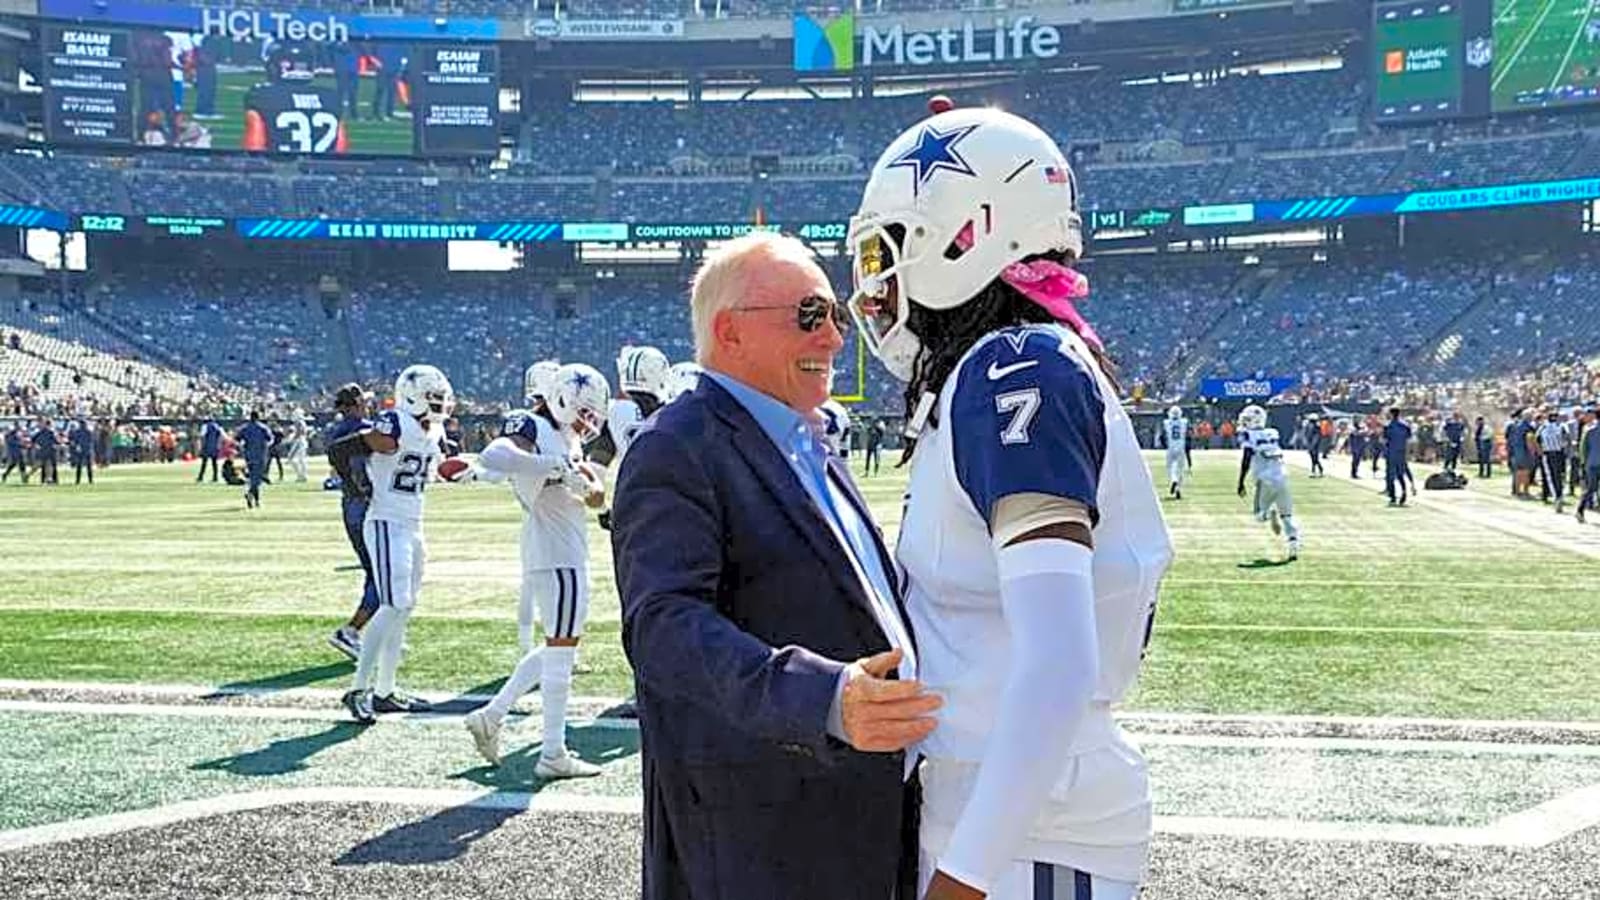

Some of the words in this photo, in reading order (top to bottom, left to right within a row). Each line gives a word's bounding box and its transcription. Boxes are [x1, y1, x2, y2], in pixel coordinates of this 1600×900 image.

[203, 8, 348, 42] HCLTech
[862, 15, 1061, 66] MetLife
[276, 111, 338, 153] 32
[1417, 193, 1489, 207] COUGARS
[1494, 189, 1542, 202] CLIMB
[82, 216, 124, 230] 12:12
[329, 224, 376, 237] KEAN
[382, 224, 477, 238] UNIVERSITY
[635, 224, 712, 237] COUNTDOWN
[715, 224, 731, 236] TO
[996, 388, 1041, 446] 7
